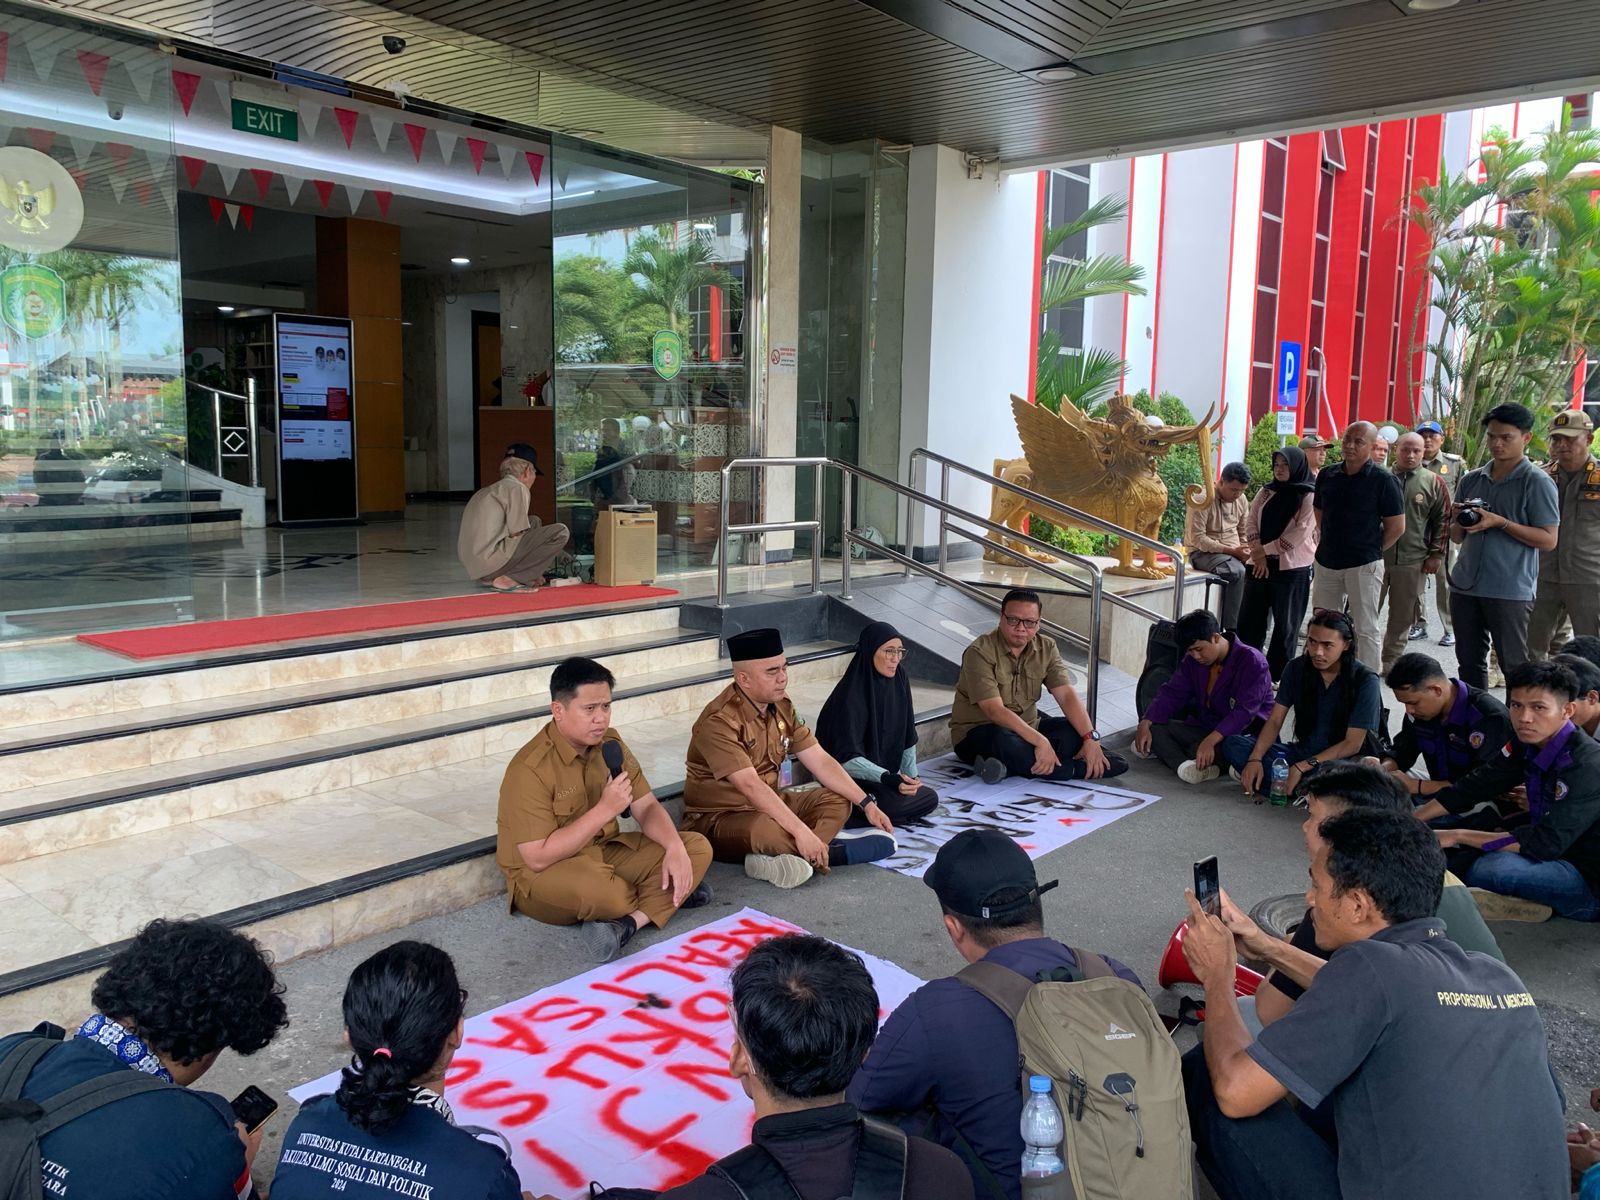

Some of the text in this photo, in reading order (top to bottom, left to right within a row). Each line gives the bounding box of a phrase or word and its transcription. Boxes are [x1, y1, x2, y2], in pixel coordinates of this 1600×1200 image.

[246, 106, 284, 134] EXIT
[1284, 351, 1294, 396] P
[1437, 991, 1497, 1009] PROPORSIONAL
[460, 990, 733, 1127] OKUS
[311, 1154, 338, 1173] ILMU
[334, 1161, 367, 1183] SOSIAL
[365, 1168, 390, 1188] DAN
[386, 1173, 434, 1200] POLITIK
[337, 1142, 365, 1159] KUTAI
[362, 1149, 428, 1177] KARTANEGARA
[331, 1177, 348, 1192] 2024
